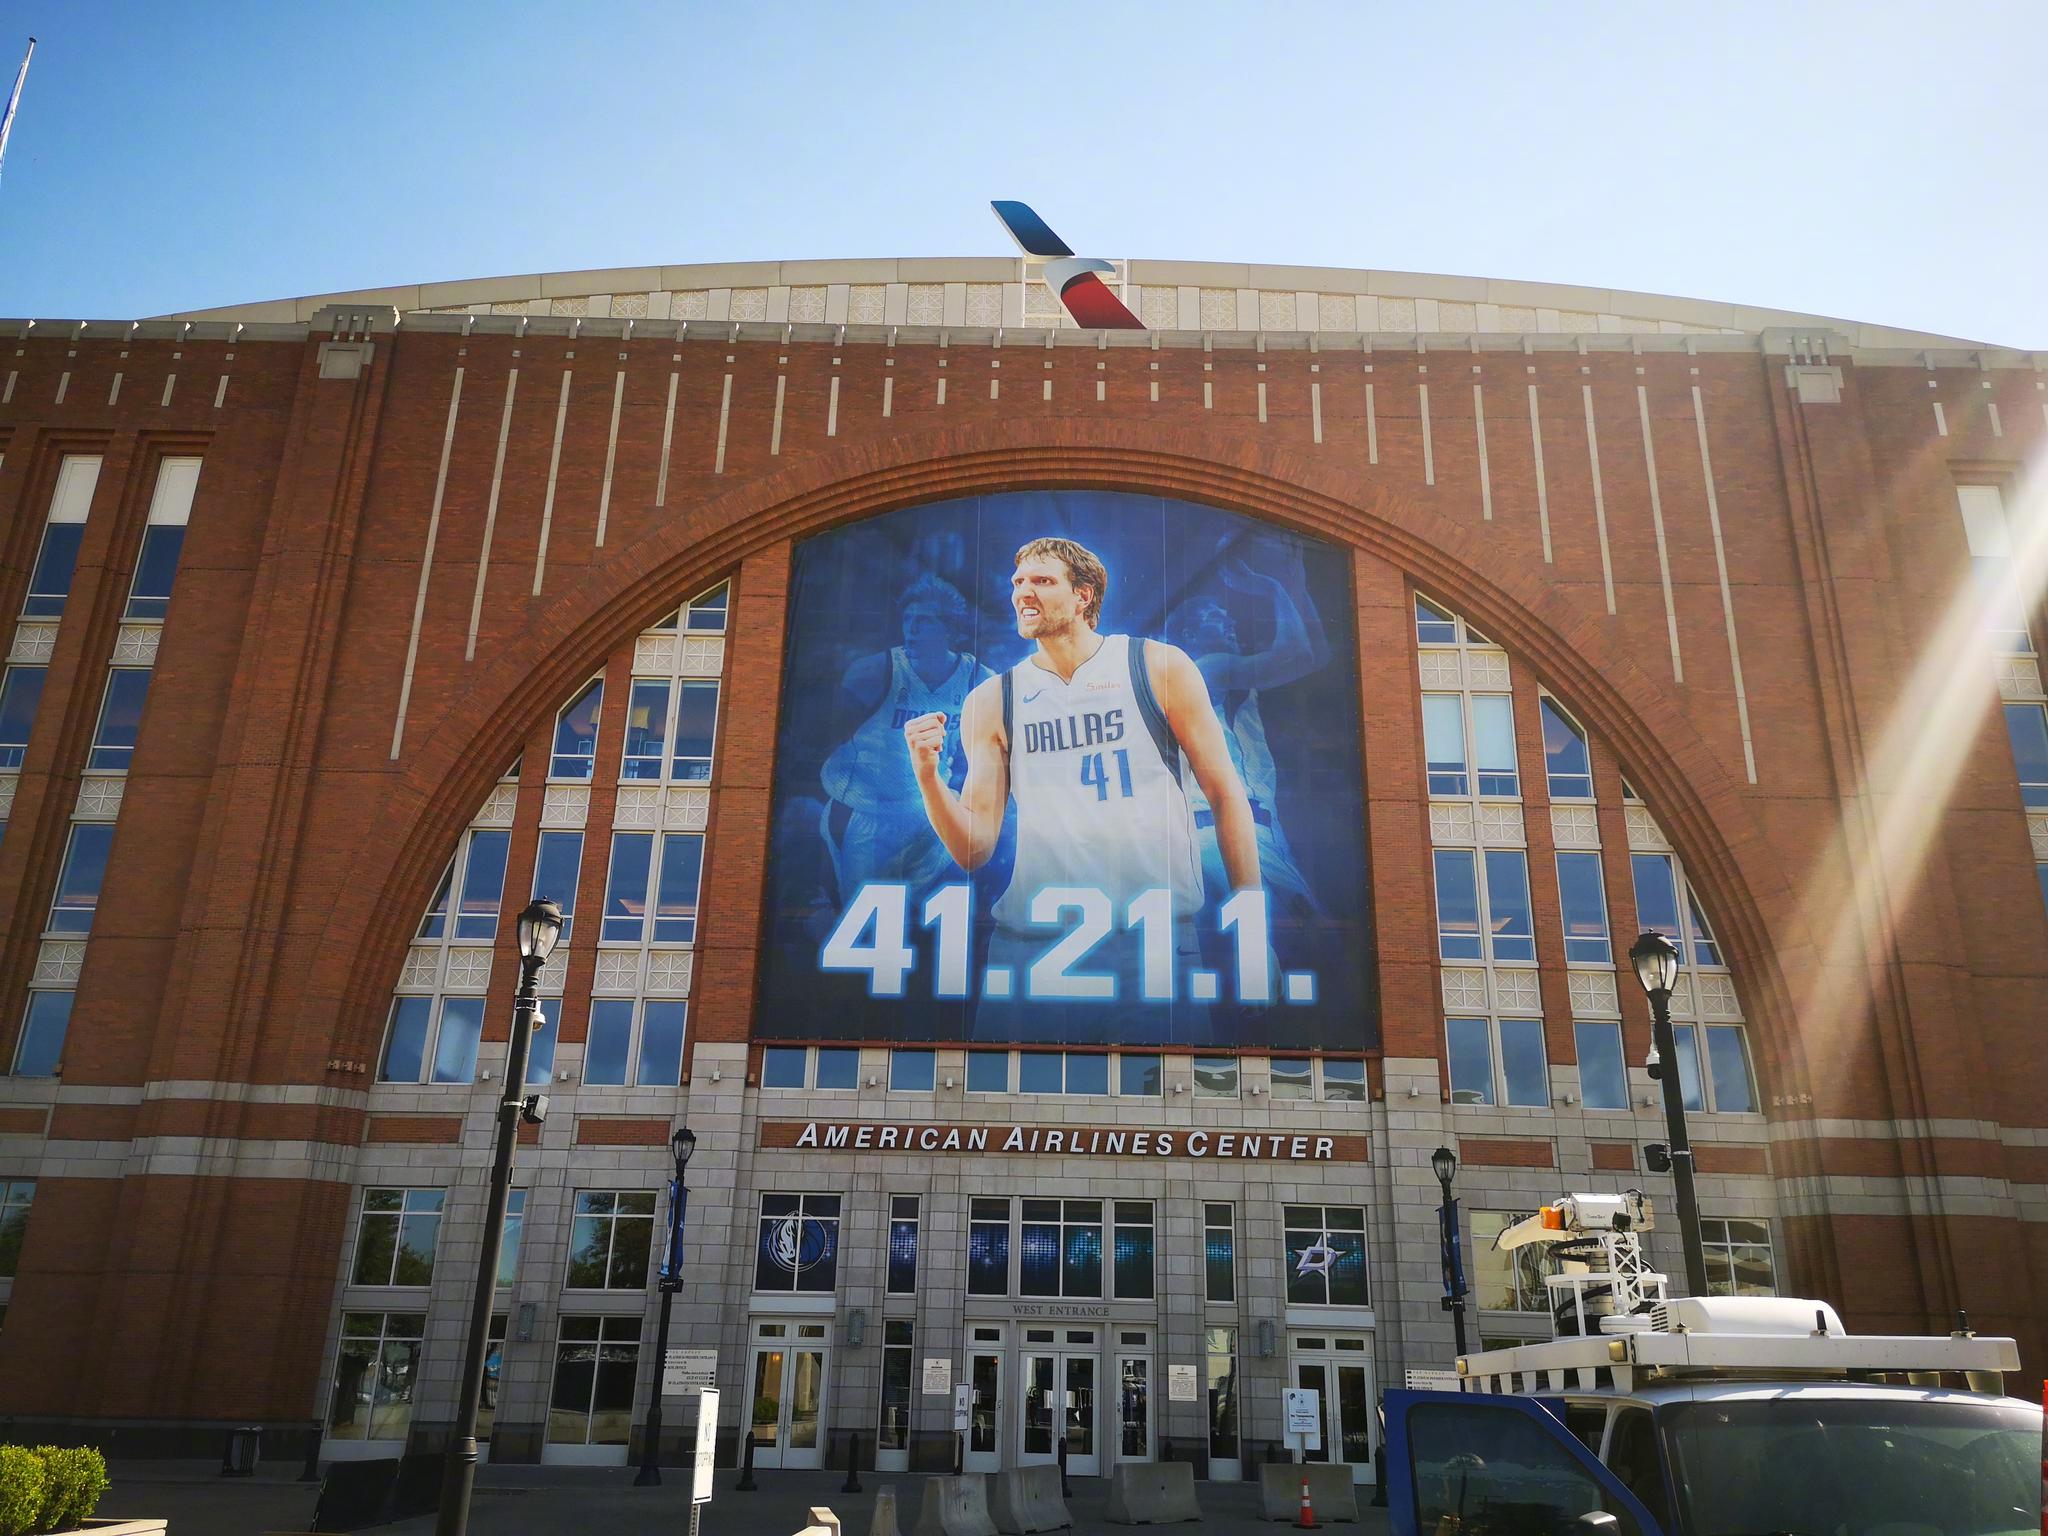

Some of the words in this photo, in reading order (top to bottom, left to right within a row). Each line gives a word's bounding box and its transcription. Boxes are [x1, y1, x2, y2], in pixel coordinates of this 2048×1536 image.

[1024, 709, 1124, 753] DALLAS
[1080, 748, 1133, 801] 41
[1013, 1304, 1044, 1315] WEST
[1049, 1305, 1110, 1317] ENTRANCE
